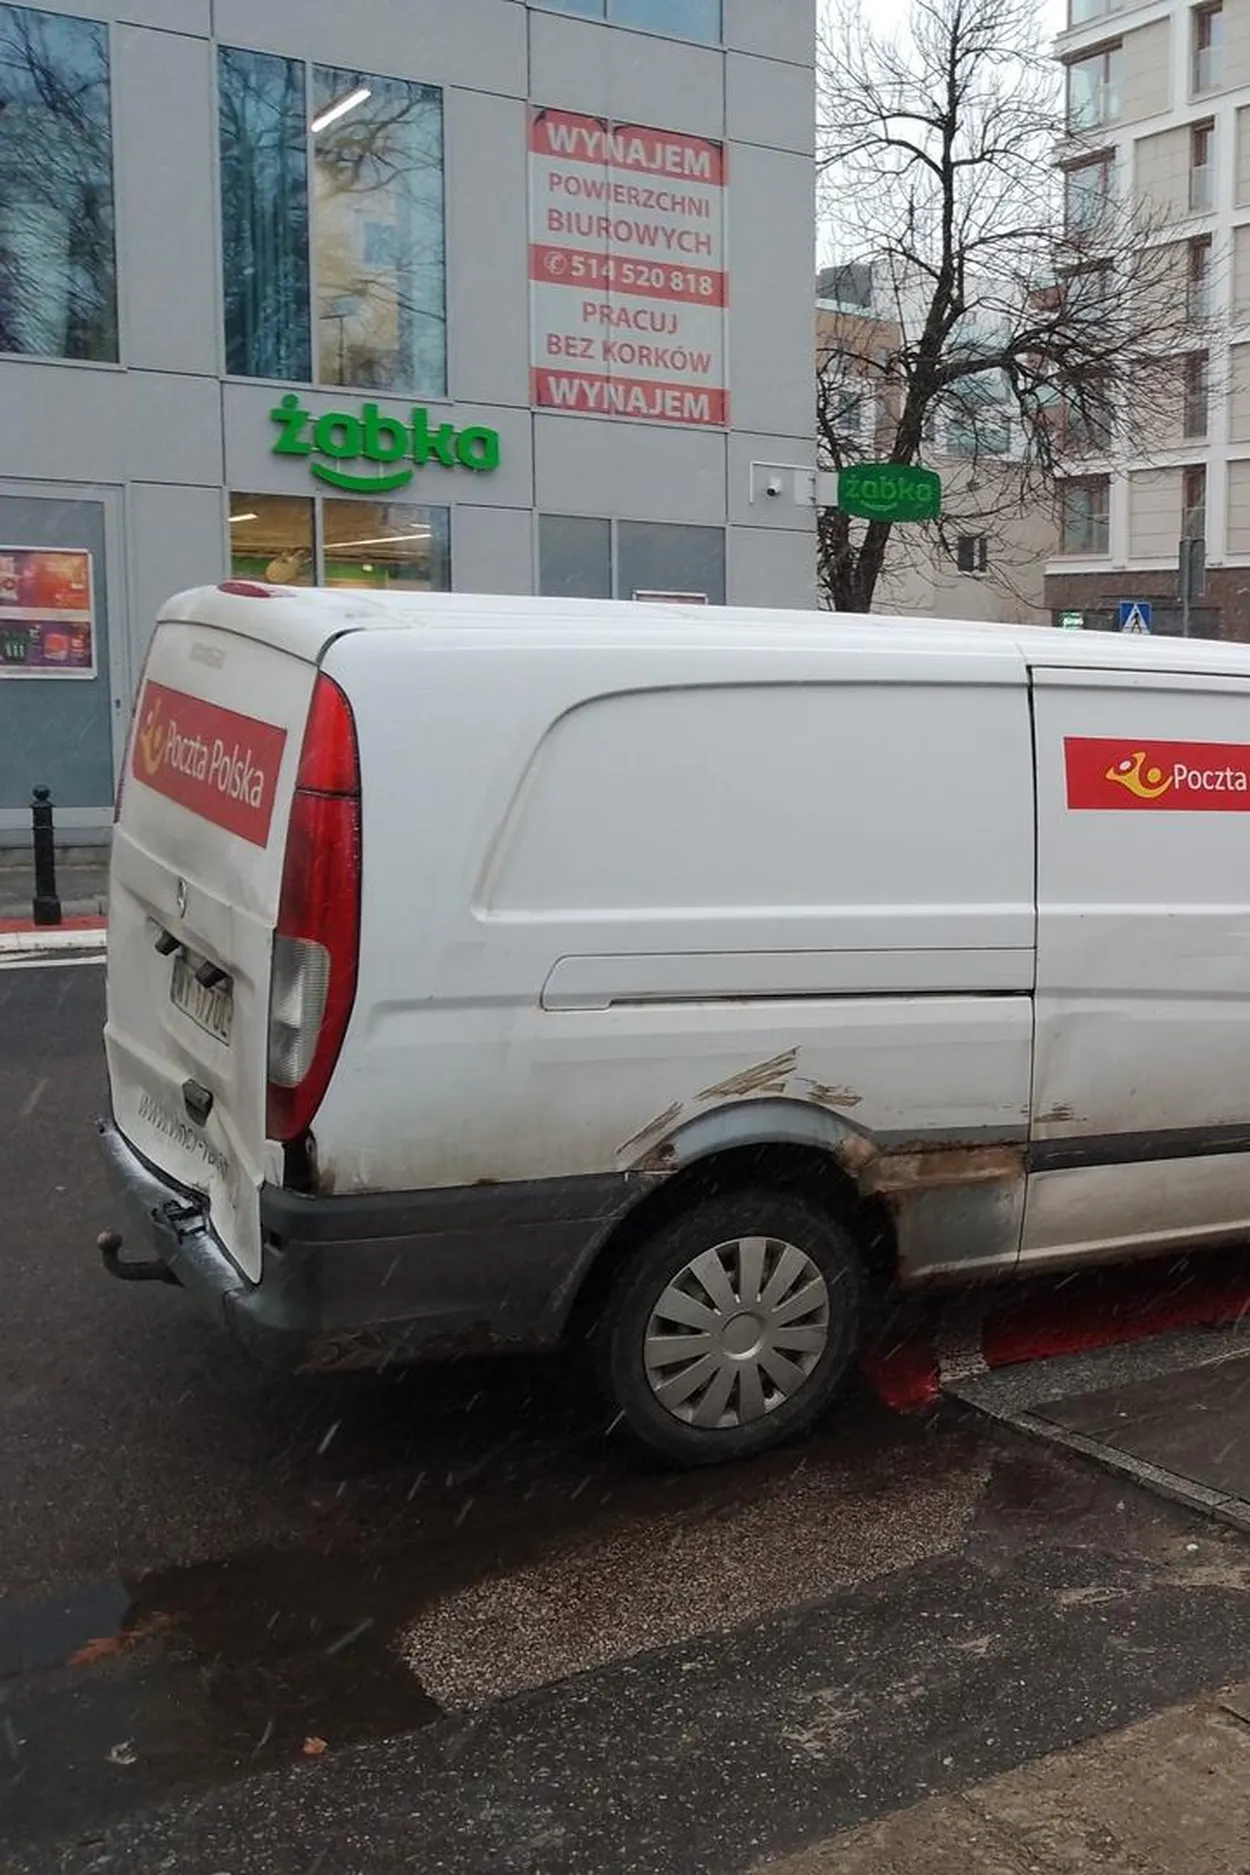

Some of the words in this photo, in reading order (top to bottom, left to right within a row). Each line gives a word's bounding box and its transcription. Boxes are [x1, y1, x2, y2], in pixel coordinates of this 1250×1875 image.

[546, 122, 710, 178] WYNAJEM
[548, 172, 710, 218] POWIERZCHNI
[547, 208, 711, 255] BIUROWYCH
[571, 257, 616, 281] 514
[622, 262, 664, 288] 520
[670, 270, 713, 296] 818
[582, 301, 678, 334] PRACUJ
[546, 333, 594, 360] BEZ
[602, 339, 711, 374] KORKÓW
[547, 375, 710, 421] WYNAJEM
[270, 393, 500, 471] żabka
[845, 475, 933, 501] żabka
[164, 720, 208, 782] Poczta
[208, 738, 265, 809] Polska
[1173, 764, 1247, 791] Poczta
